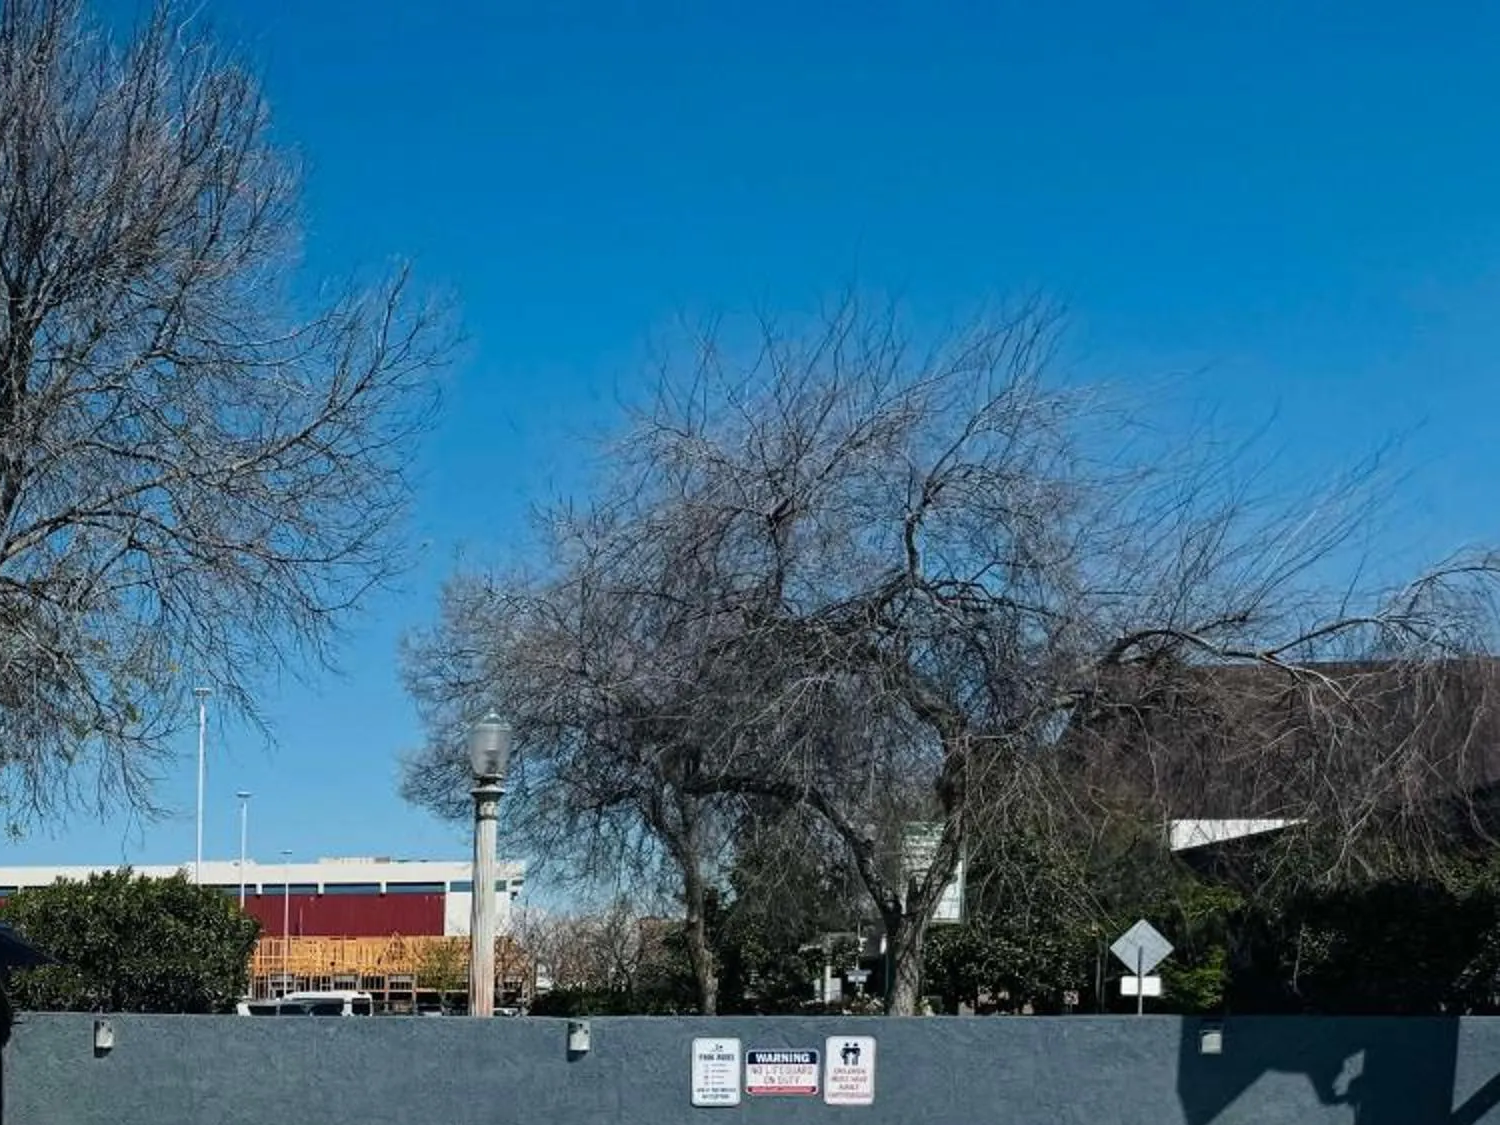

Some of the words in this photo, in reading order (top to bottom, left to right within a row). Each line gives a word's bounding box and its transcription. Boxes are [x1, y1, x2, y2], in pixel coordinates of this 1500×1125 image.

[755, 1053, 810, 1062] WARNING
[751, 1066, 762, 1074] NO
[766, 1066, 813, 1075] LIFEGUARD
[763, 1076, 776, 1084] ON
